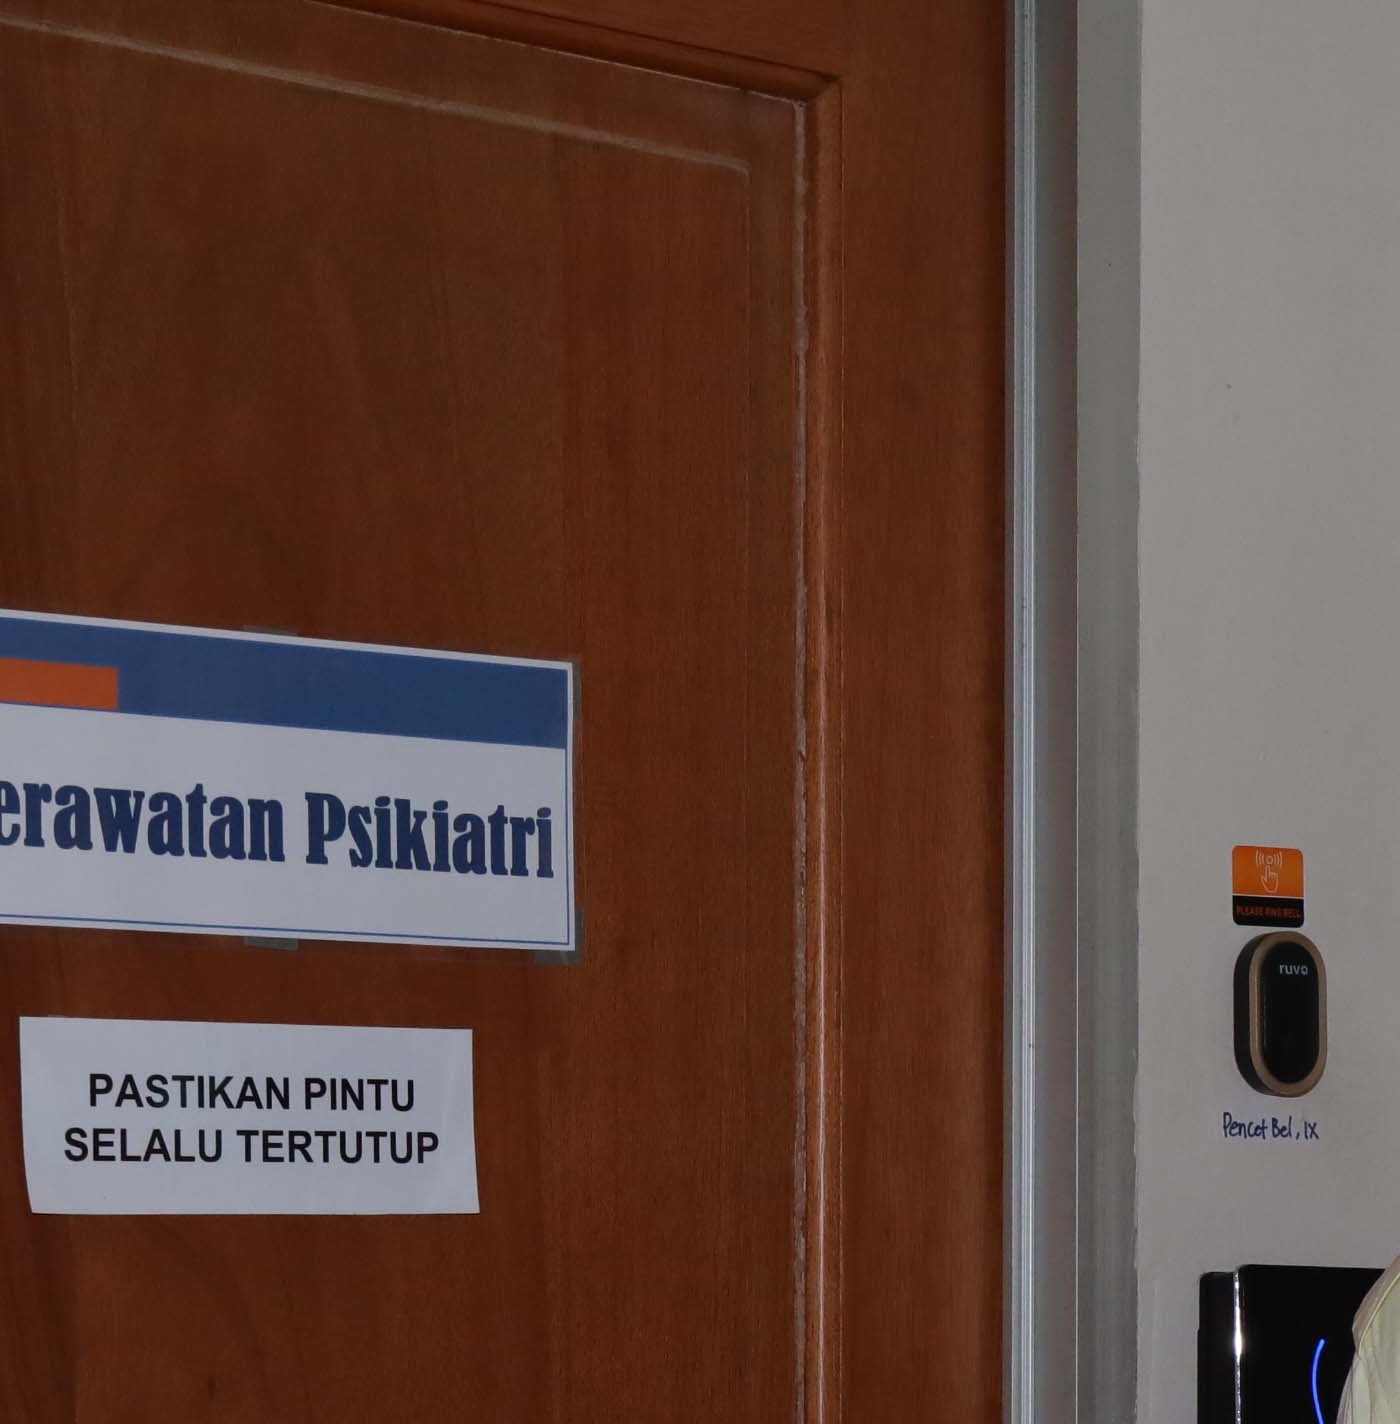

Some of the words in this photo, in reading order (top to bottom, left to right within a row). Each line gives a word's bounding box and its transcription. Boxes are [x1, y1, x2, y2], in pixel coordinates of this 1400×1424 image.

[303, 791, 555, 878] Psikiatri
[88, 1072, 291, 1111] PASTIKAN
[303, 1077, 416, 1112] PINTU
[63, 1127, 224, 1163] SELALU
[236, 1129, 440, 1165] TERTUTUP
